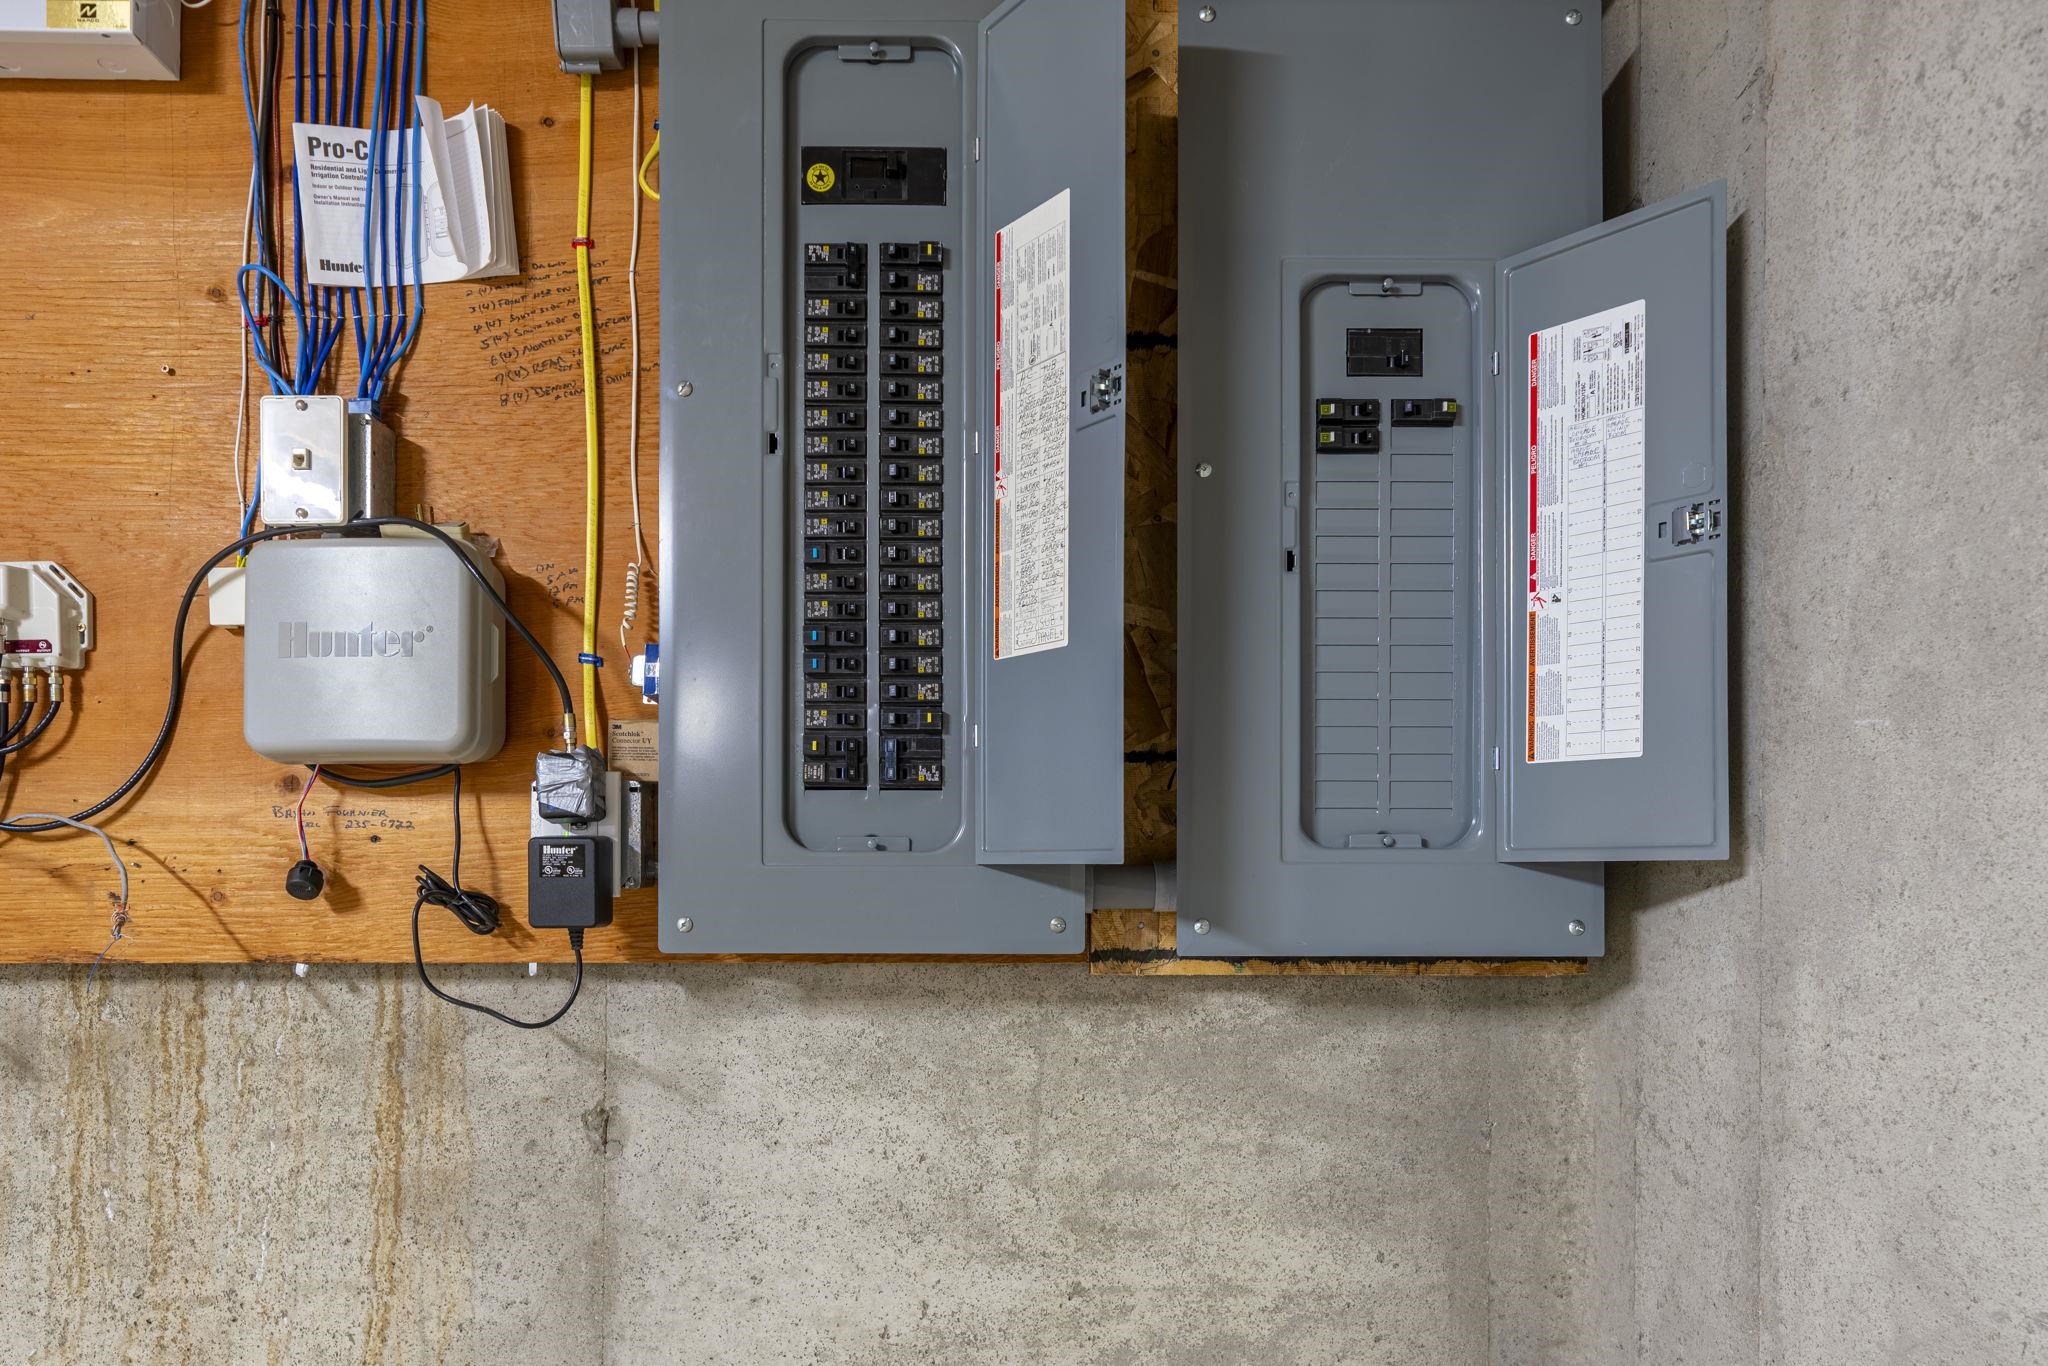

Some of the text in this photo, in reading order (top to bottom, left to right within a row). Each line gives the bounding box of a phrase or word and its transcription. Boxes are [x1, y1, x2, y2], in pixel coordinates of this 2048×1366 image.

[307, 136, 369, 161] Pro-C
[310, 164, 345, 173] Residential
[346, 165, 357, 173] and
[311, 172, 367, 181] Irrigation Controlle
[319, 259, 364, 274] Hunte
[278, 621, 425, 658] Hunter
[543, 845, 576, 855] Hunter
